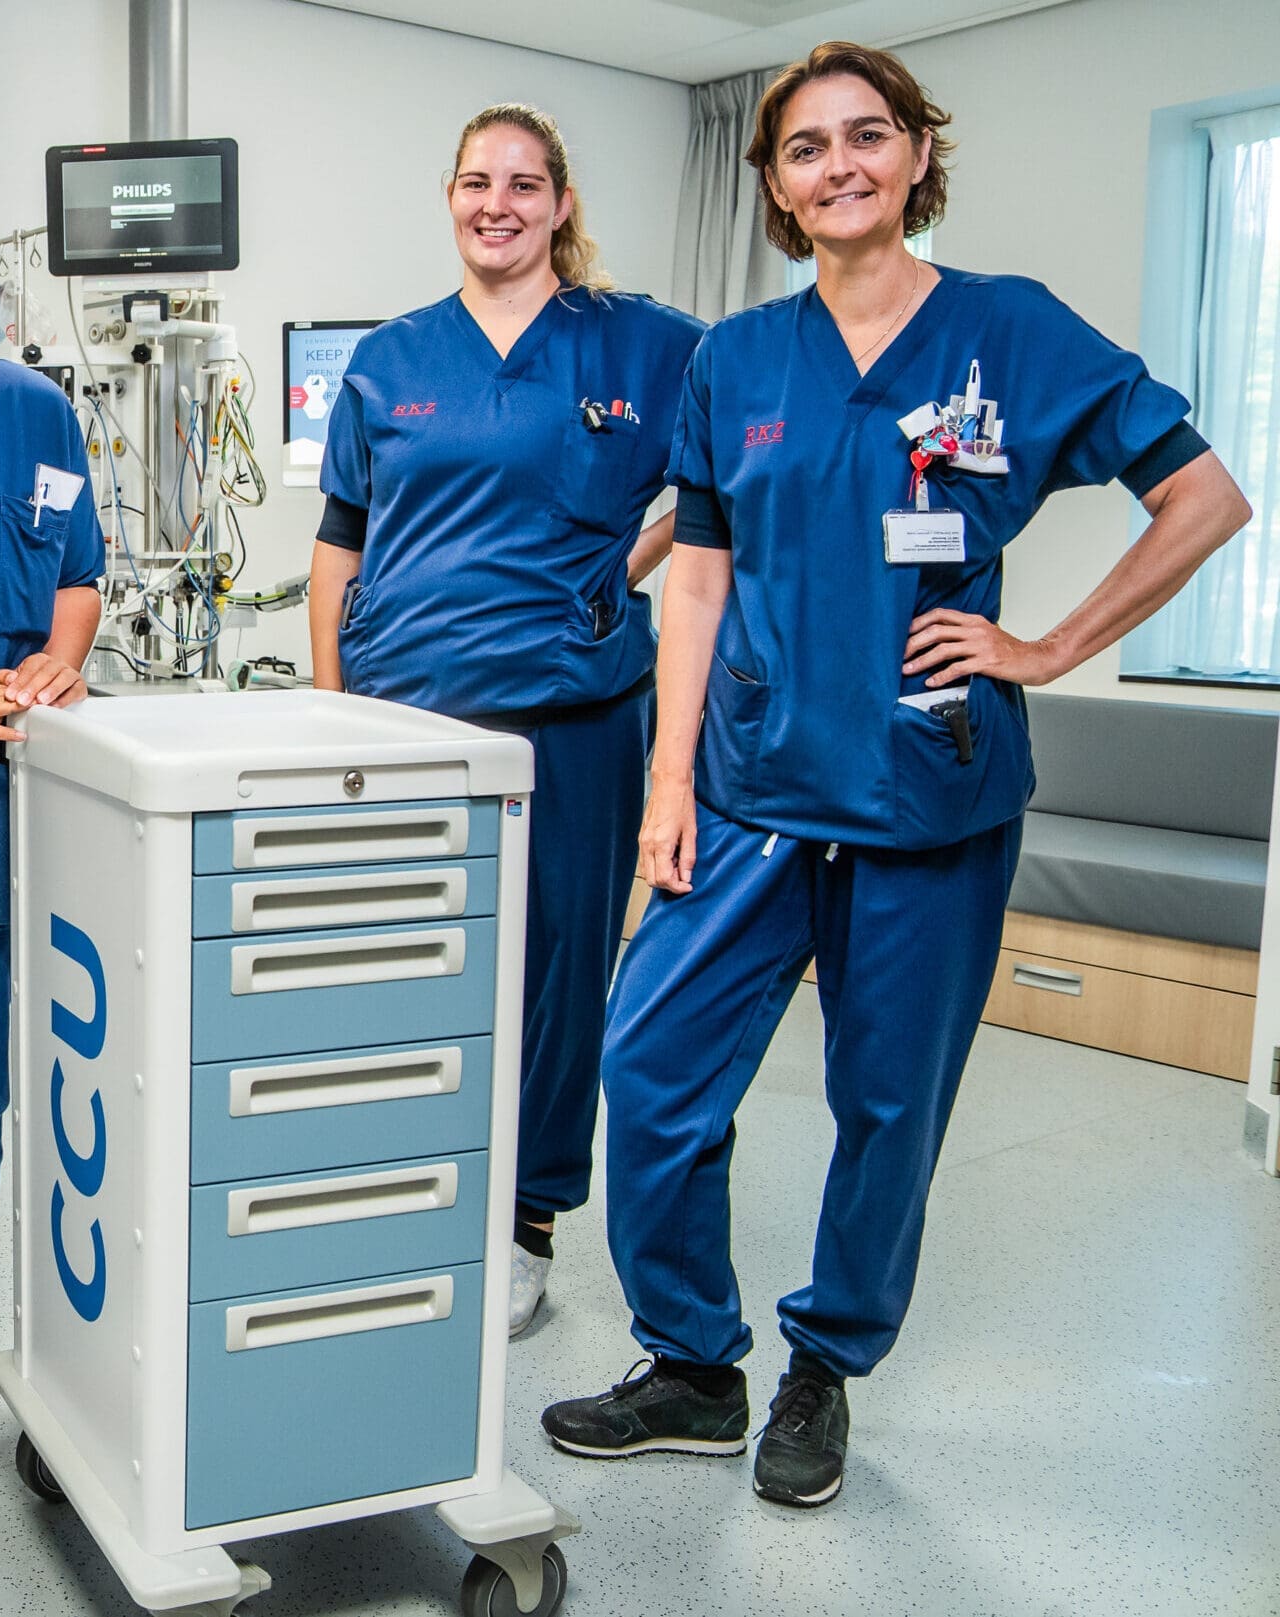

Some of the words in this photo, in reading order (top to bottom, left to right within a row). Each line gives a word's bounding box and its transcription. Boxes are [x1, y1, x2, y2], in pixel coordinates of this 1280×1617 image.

[112, 183, 172, 198] PHILIPS
[306, 349, 343, 361] KEEP
[393, 402, 437, 415] RKZ
[744, 421, 785, 444] RKZ
[50, 912, 107, 1322] CCU
